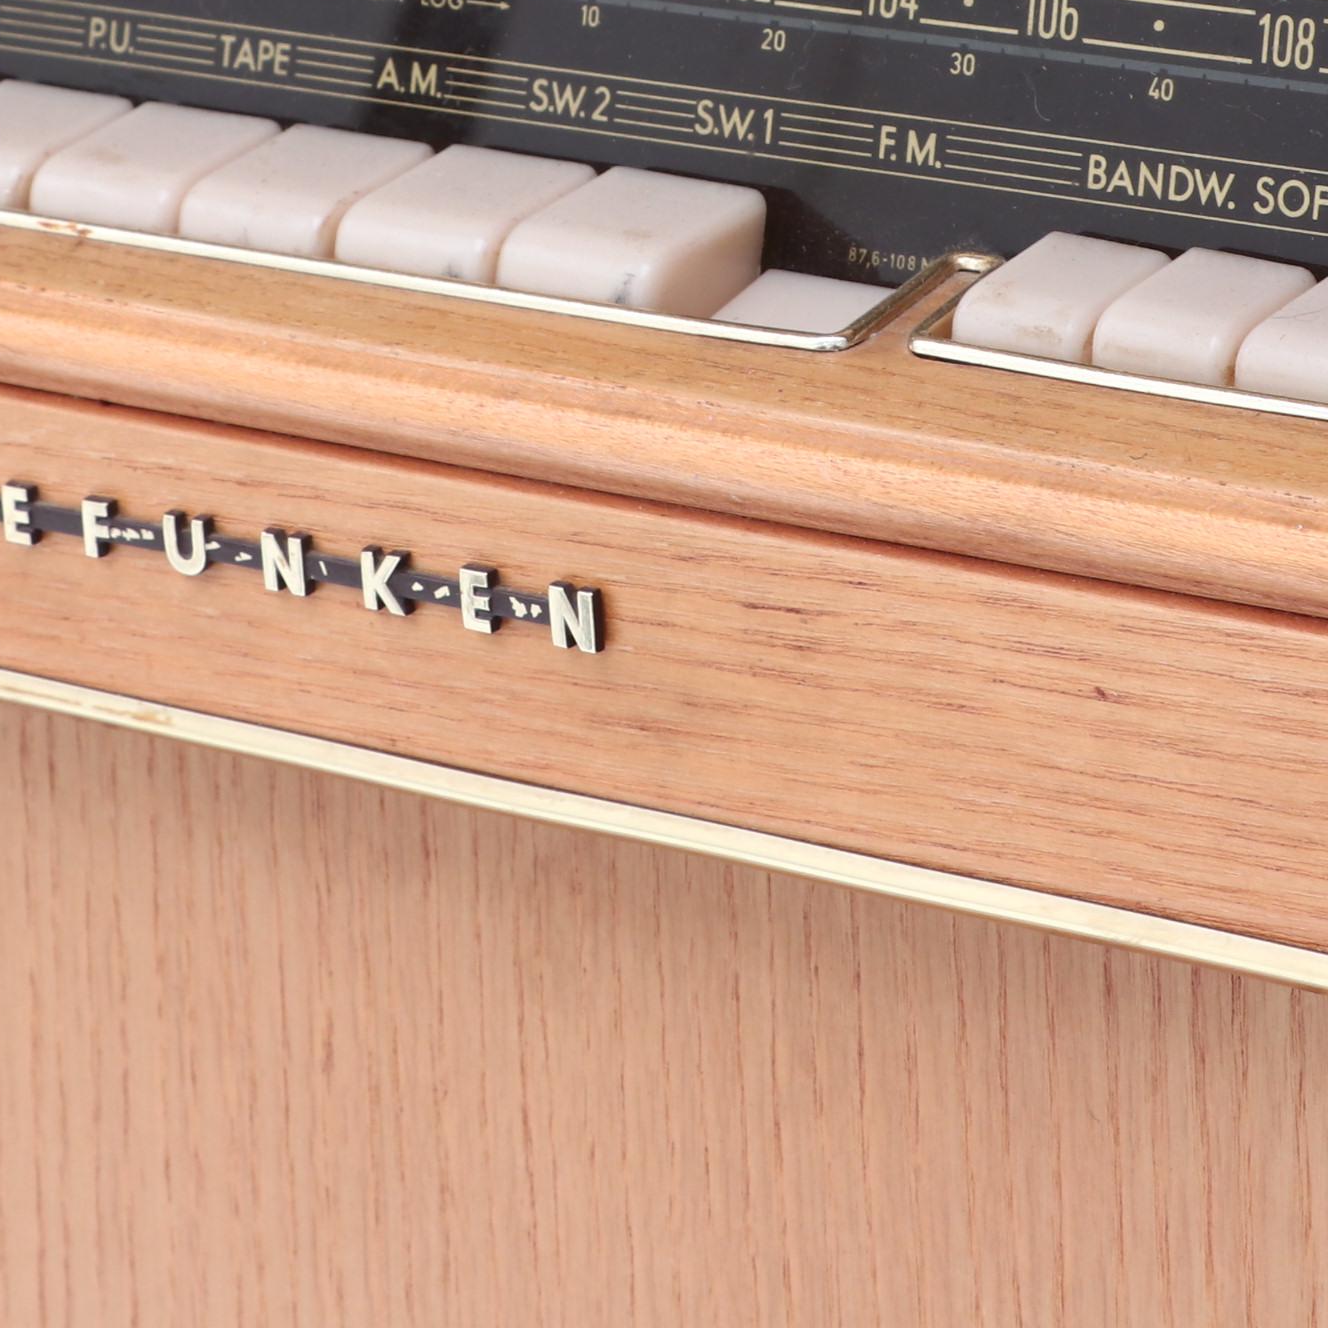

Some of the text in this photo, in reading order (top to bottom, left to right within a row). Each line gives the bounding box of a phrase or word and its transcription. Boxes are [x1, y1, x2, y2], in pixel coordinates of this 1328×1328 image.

[581, 5, 600, 27] 10
[762, 30, 785, 51] 20
[950, 53, 974, 76] 30
[1149, 78, 1173, 101] 40
[1258, 15, 1315, 70] 108
[88, 19, 134, 54] P.U.
[220, 35, 291, 75] TAPE
[376, 58, 443, 97] A.M.
[1087, 154, 1236, 209] BANDW.
[848, 247, 915, 271] 87,6-108
